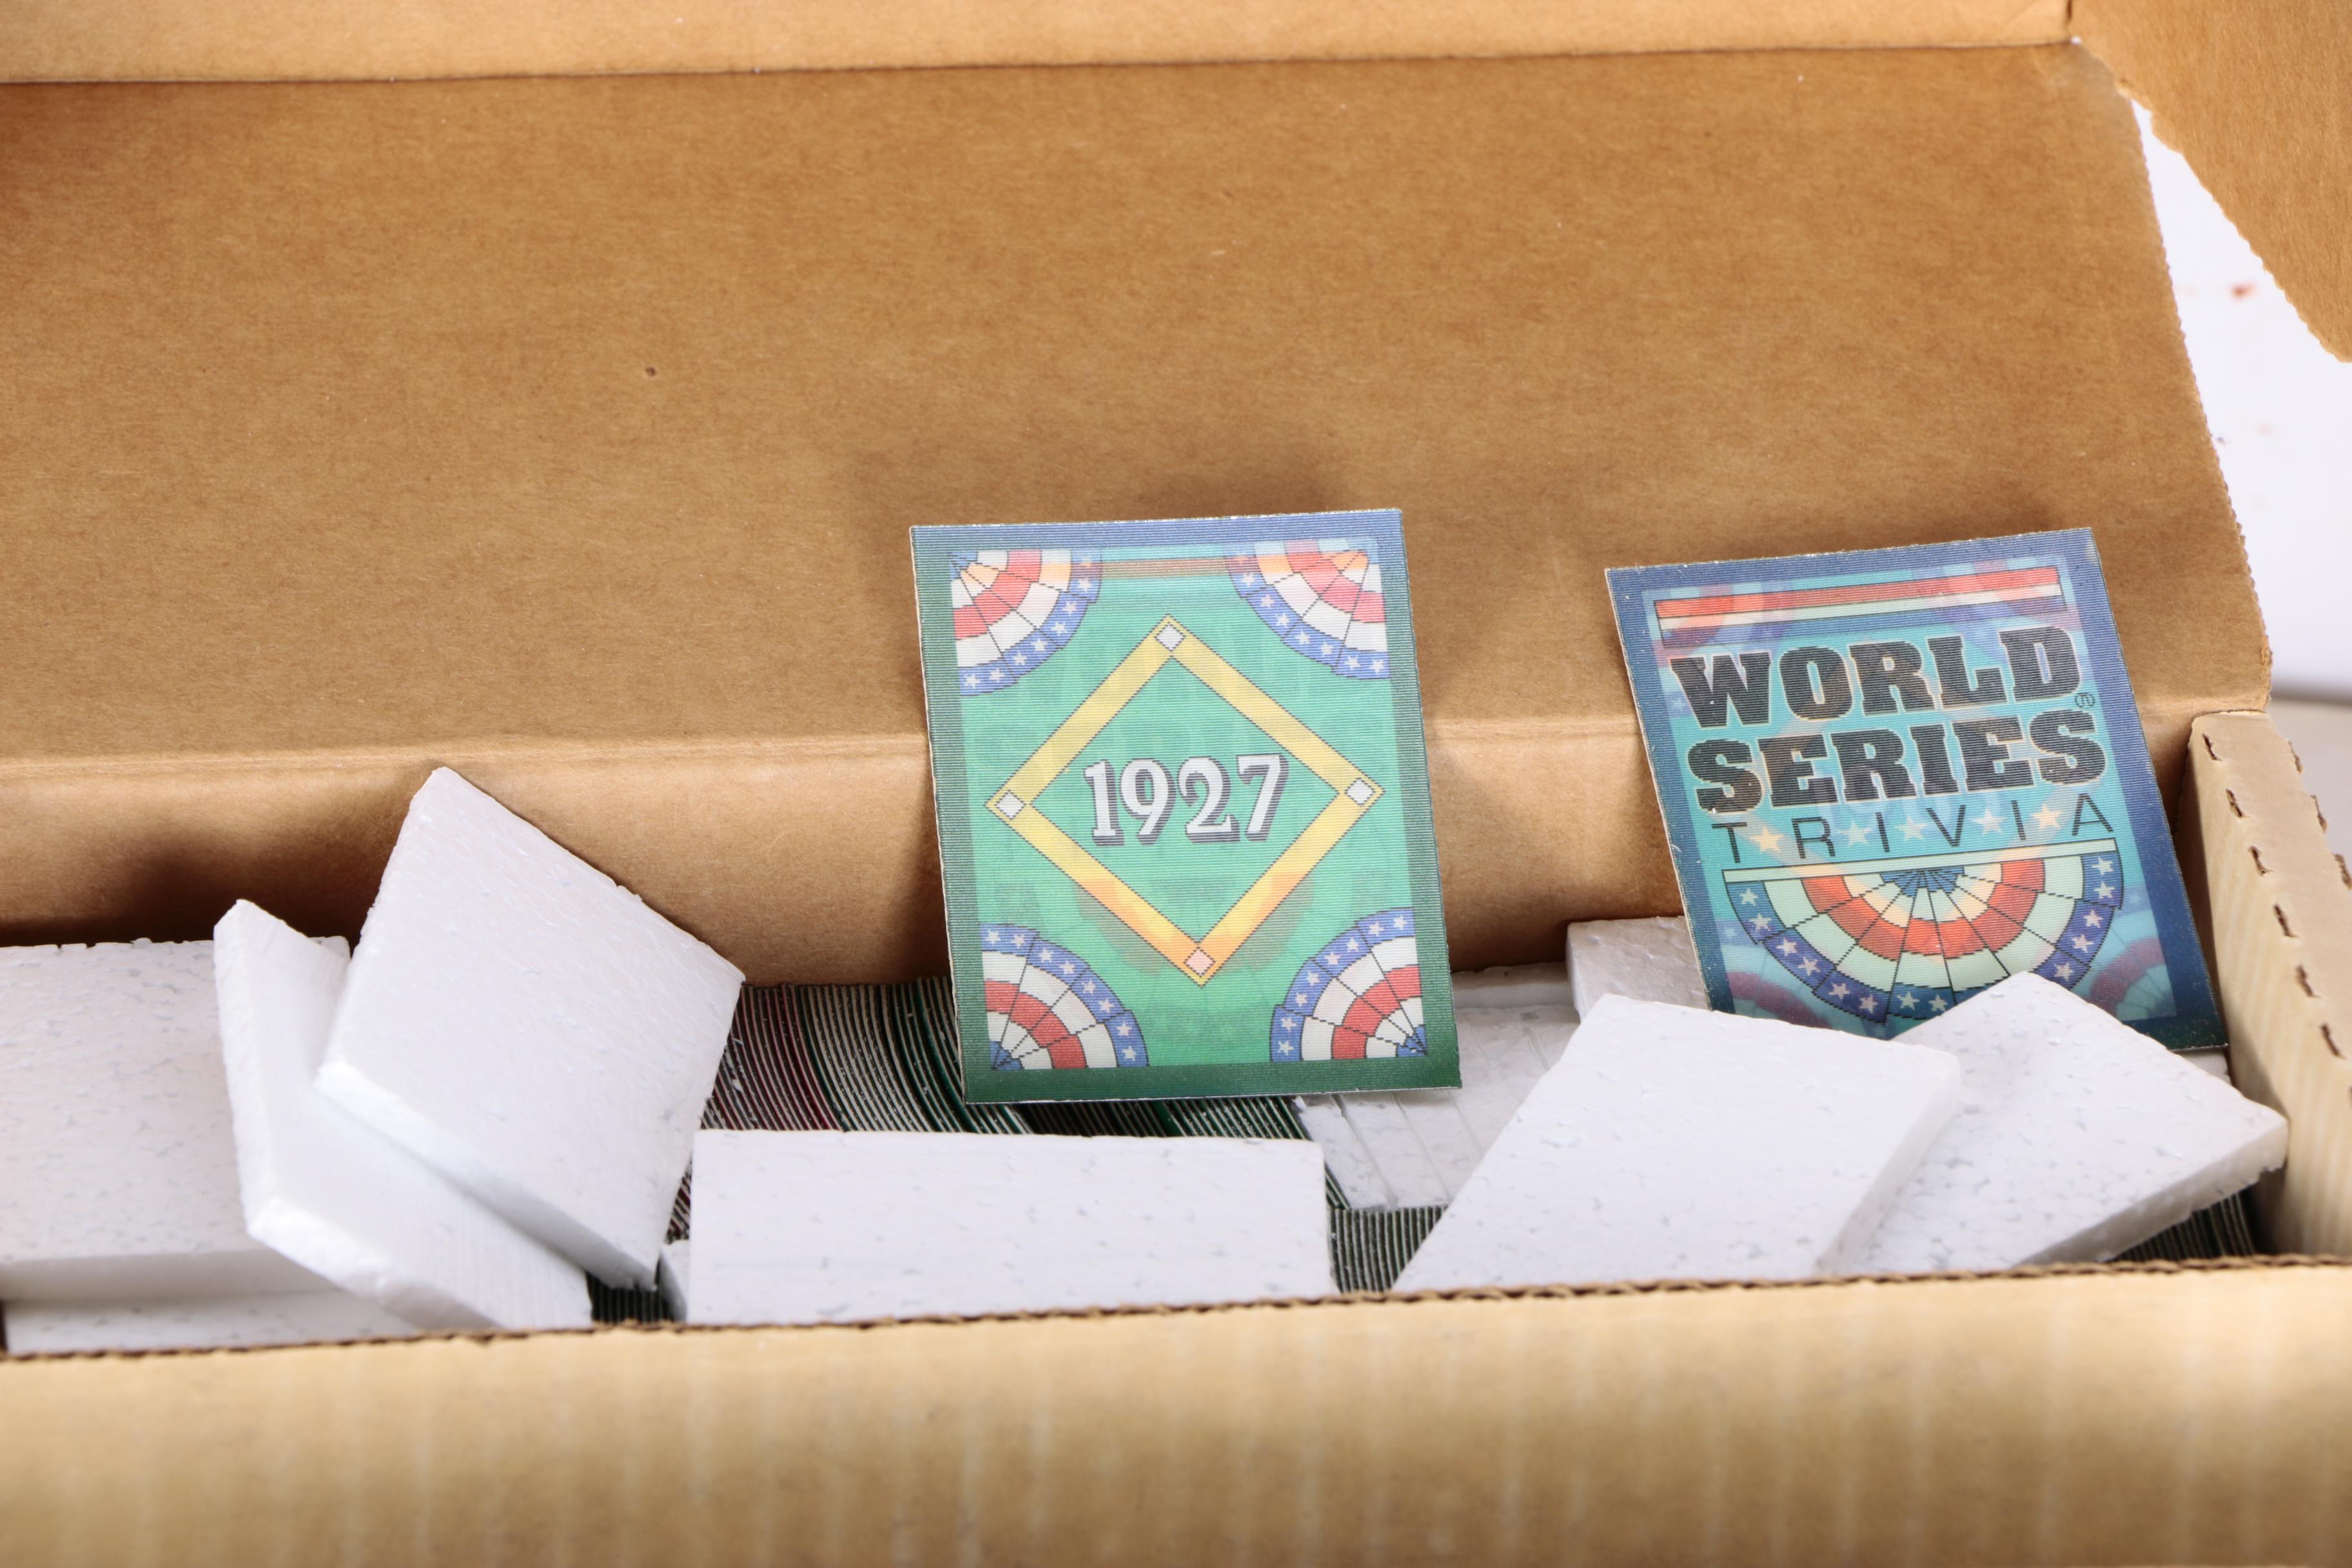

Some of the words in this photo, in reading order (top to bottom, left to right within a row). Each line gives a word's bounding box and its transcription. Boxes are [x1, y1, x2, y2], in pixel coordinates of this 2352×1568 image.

[1671, 626, 2081, 728] WORLD
[1084, 753, 1288, 847] 1927
[1686, 709, 2106, 813] SERIES
[1712, 793, 2113, 863] TRIVIA
